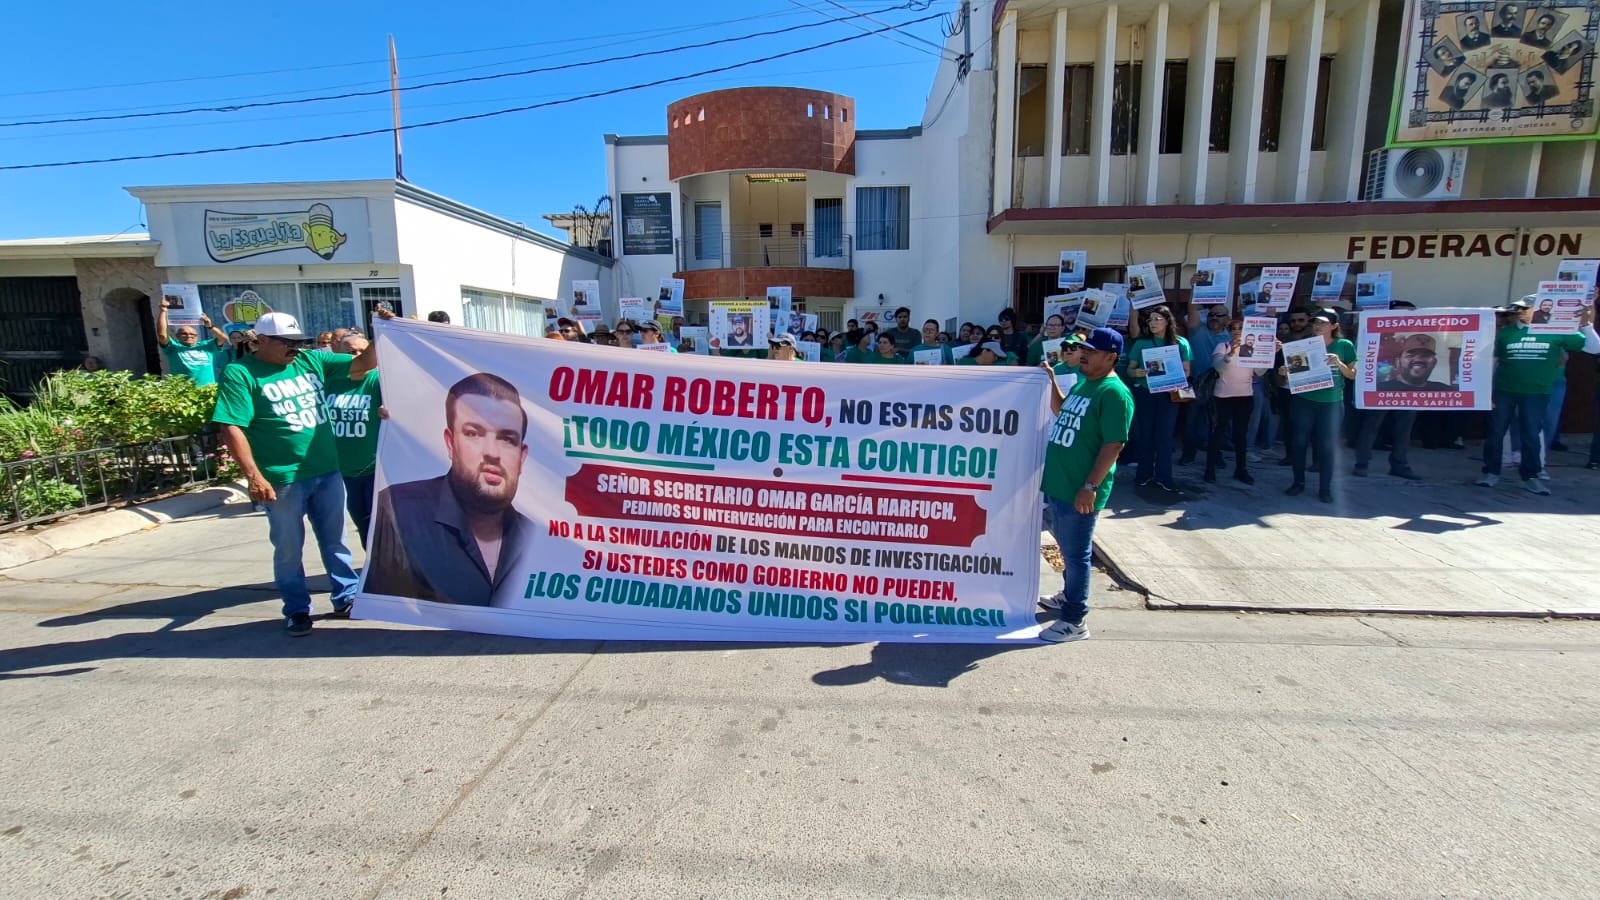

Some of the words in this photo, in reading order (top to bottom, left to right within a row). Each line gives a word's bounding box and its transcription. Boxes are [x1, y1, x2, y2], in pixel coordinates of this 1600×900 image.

[230, 220, 304, 248] Escuelita
[1347, 233, 1582, 260] FEDERACION
[1376, 317, 1470, 328] DESAPARECIDO
[1365, 339, 1377, 383] URGENTE
[1463, 338, 1476, 383] URGENTE
[263, 372, 324, 402] OMAR
[272, 399, 297, 417] NO
[327, 393, 372, 409] OMAR
[549, 366, 655, 410] OMAR
[663, 376, 832, 428] ROBERTO,
[840, 399, 872, 425] NO
[879, 401, 953, 431] ESTAS
[959, 406, 1019, 436] SOLO
[341, 409, 370, 421] ESTA
[562, 415, 651, 453] ¡TODO
[656, 421, 771, 463] MÉXICO
[778, 432, 850, 468] ESTA
[858, 438, 998, 479] CONTIGO!
[597, 472, 650, 495] SEÑOR
[653, 480, 754, 507] SECRETARIO
[757, 488, 807, 511] OMAR
[810, 491, 873, 515] GARCÍA
[876, 497, 957, 522] HARFUCH,
[622, 499, 681, 518] PEDIMOS
[683, 504, 701, 520] SU
[703, 508, 796, 530] INTERVENCIÓN
[799, 516, 834, 533] PARA
[836, 519, 929, 539] ENCONTRARLO
[548, 519, 570, 538] NO
[573, 523, 584, 540] A
[587, 524, 605, 543] LA
[609, 526, 713, 552] SIMULACIÓN
[716, 534, 736, 554] DE
[740, 537, 770, 557] LOS
[774, 541, 847, 565] MANDOS
[850, 547, 871, 567] DE
[874, 549, 1014, 576] INVESTIGACIÓN...
[524, 570, 582, 600] ¡LOS
[585, 574, 742, 615] CIUDADANOS
[747, 590, 838, 622] UNIDOS
[844, 598, 868, 624] SI
[582, 549, 603, 570] SI
[606, 552, 688, 580] USTEDES
[692, 560, 748, 585] COMO
[752, 565, 848, 593] GOBIERNO
[852, 574, 879, 596] NO
[882, 577, 958, 603] PUEDEN,
